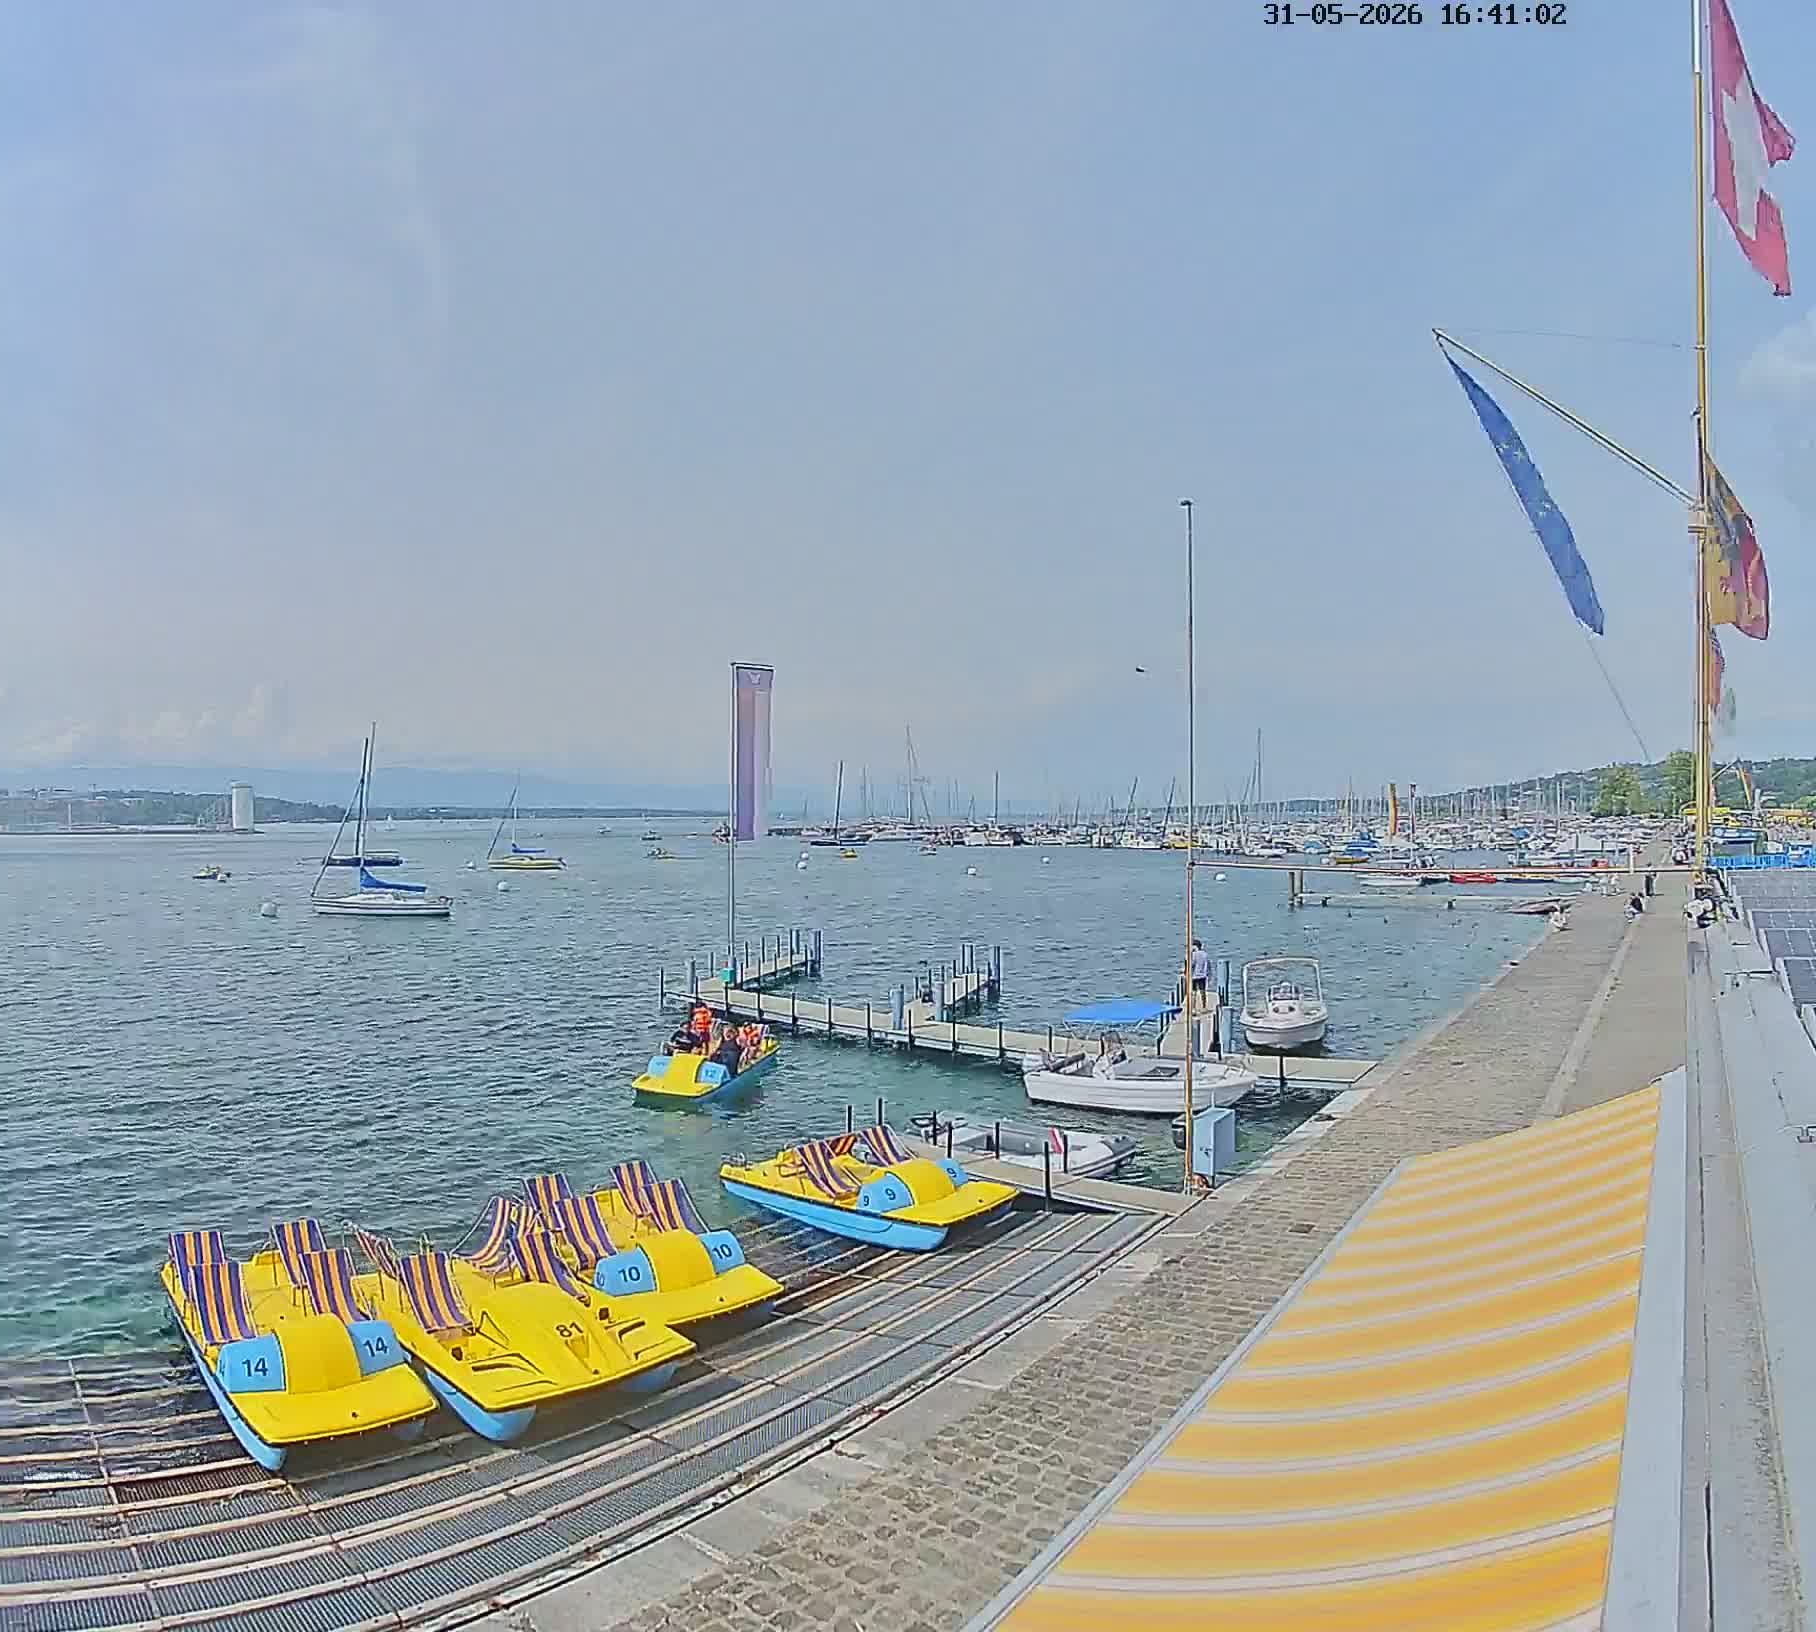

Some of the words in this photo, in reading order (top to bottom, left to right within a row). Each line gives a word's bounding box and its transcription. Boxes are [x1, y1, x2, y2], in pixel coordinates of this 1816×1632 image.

[946, 1167, 957, 1178] 9
[864, 1196, 870, 1206] 9
[885, 1188, 896, 1200] 9
[711, 1243, 733, 1260] 10
[618, 1266, 641, 1283] 10
[556, 1321, 584, 1338] 81
[363, 1336, 388, 1358] 14
[242, 1357, 269, 1377] 14
